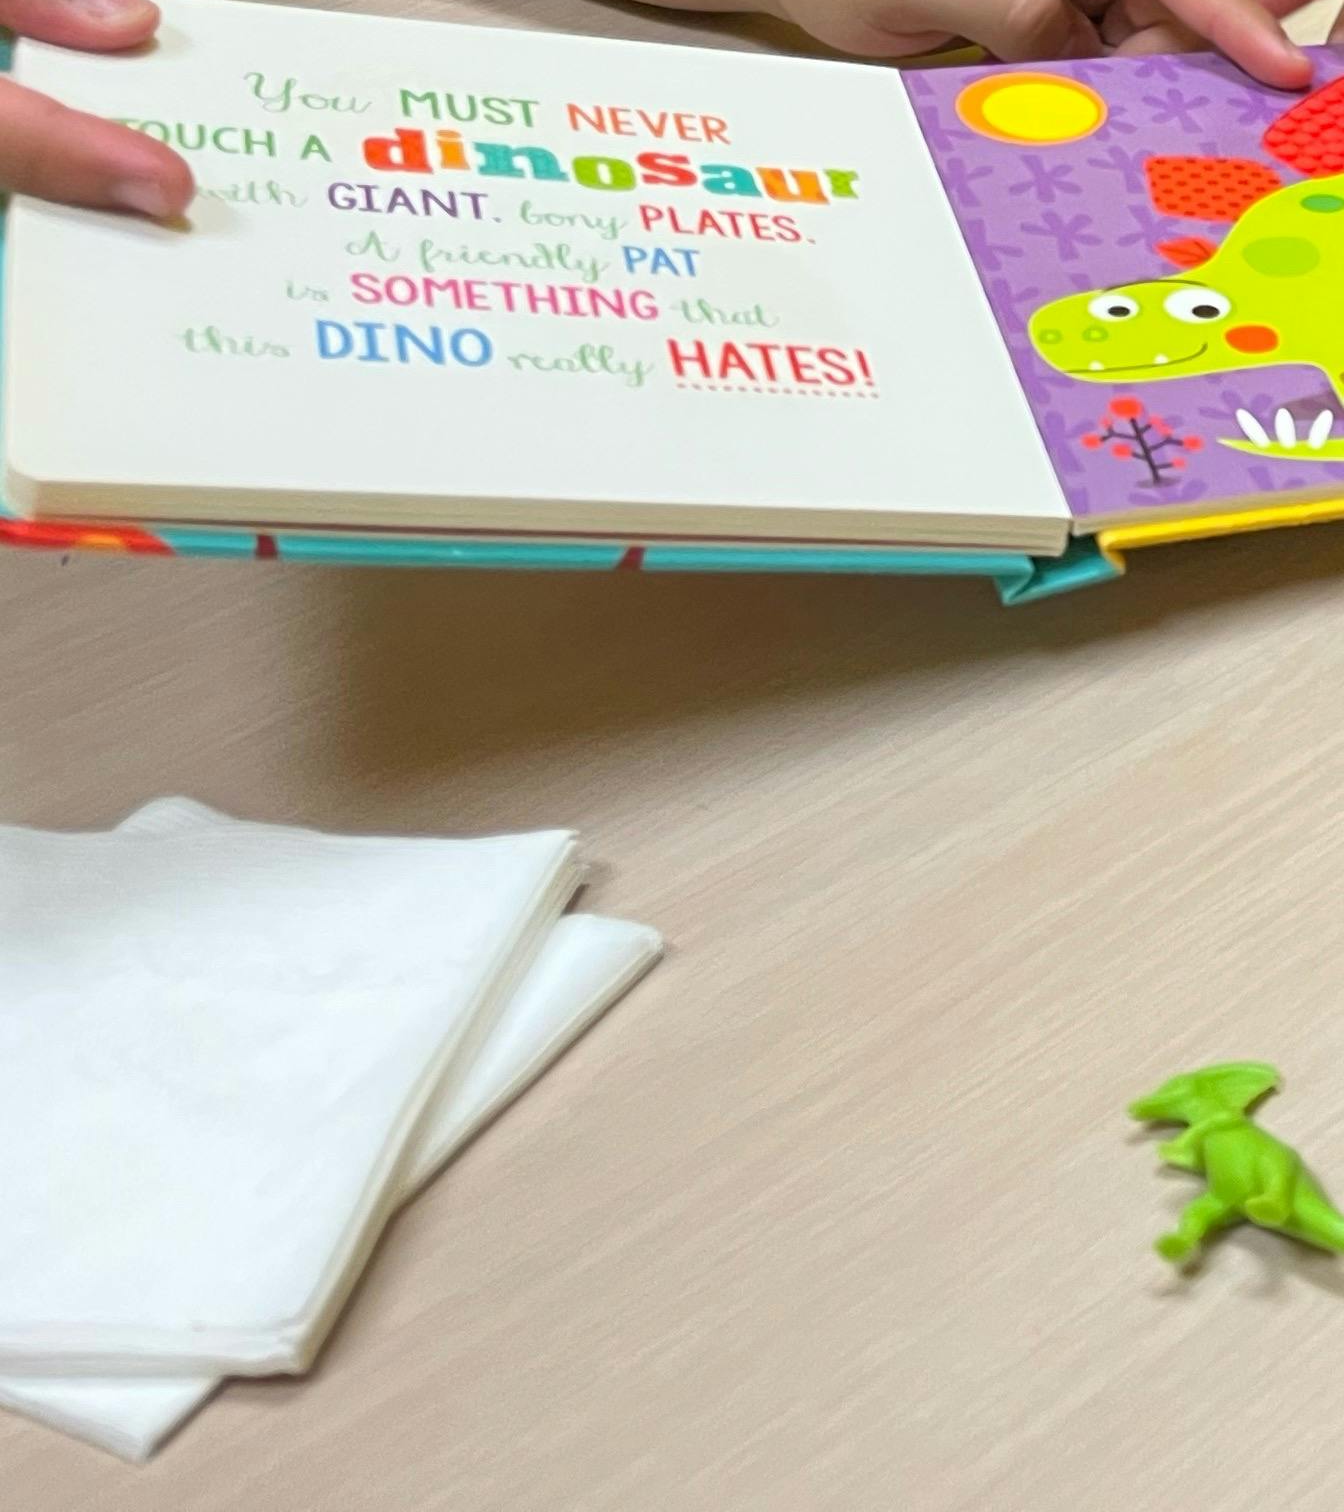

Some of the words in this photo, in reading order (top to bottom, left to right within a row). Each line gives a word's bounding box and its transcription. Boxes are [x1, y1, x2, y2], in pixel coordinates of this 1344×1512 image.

[243, 71, 373, 115] You
[399, 88, 540, 129] MUST
[566, 102, 733, 146] NEVER
[300, 134, 333, 163] A
[362, 126, 861, 205] dinosaur
[518, 198, 627, 241] bony
[344, 229, 402, 263] A
[419, 238, 612, 283] friendly
[621, 245, 701, 278] PAT
[350, 272, 660, 321] SOMETHING
[671, 297, 781, 329] that
[177, 325, 291, 359] this
[314, 317, 494, 368] DINO
[507, 342, 654, 388] really
[666, 337, 876, 389] HATES!
